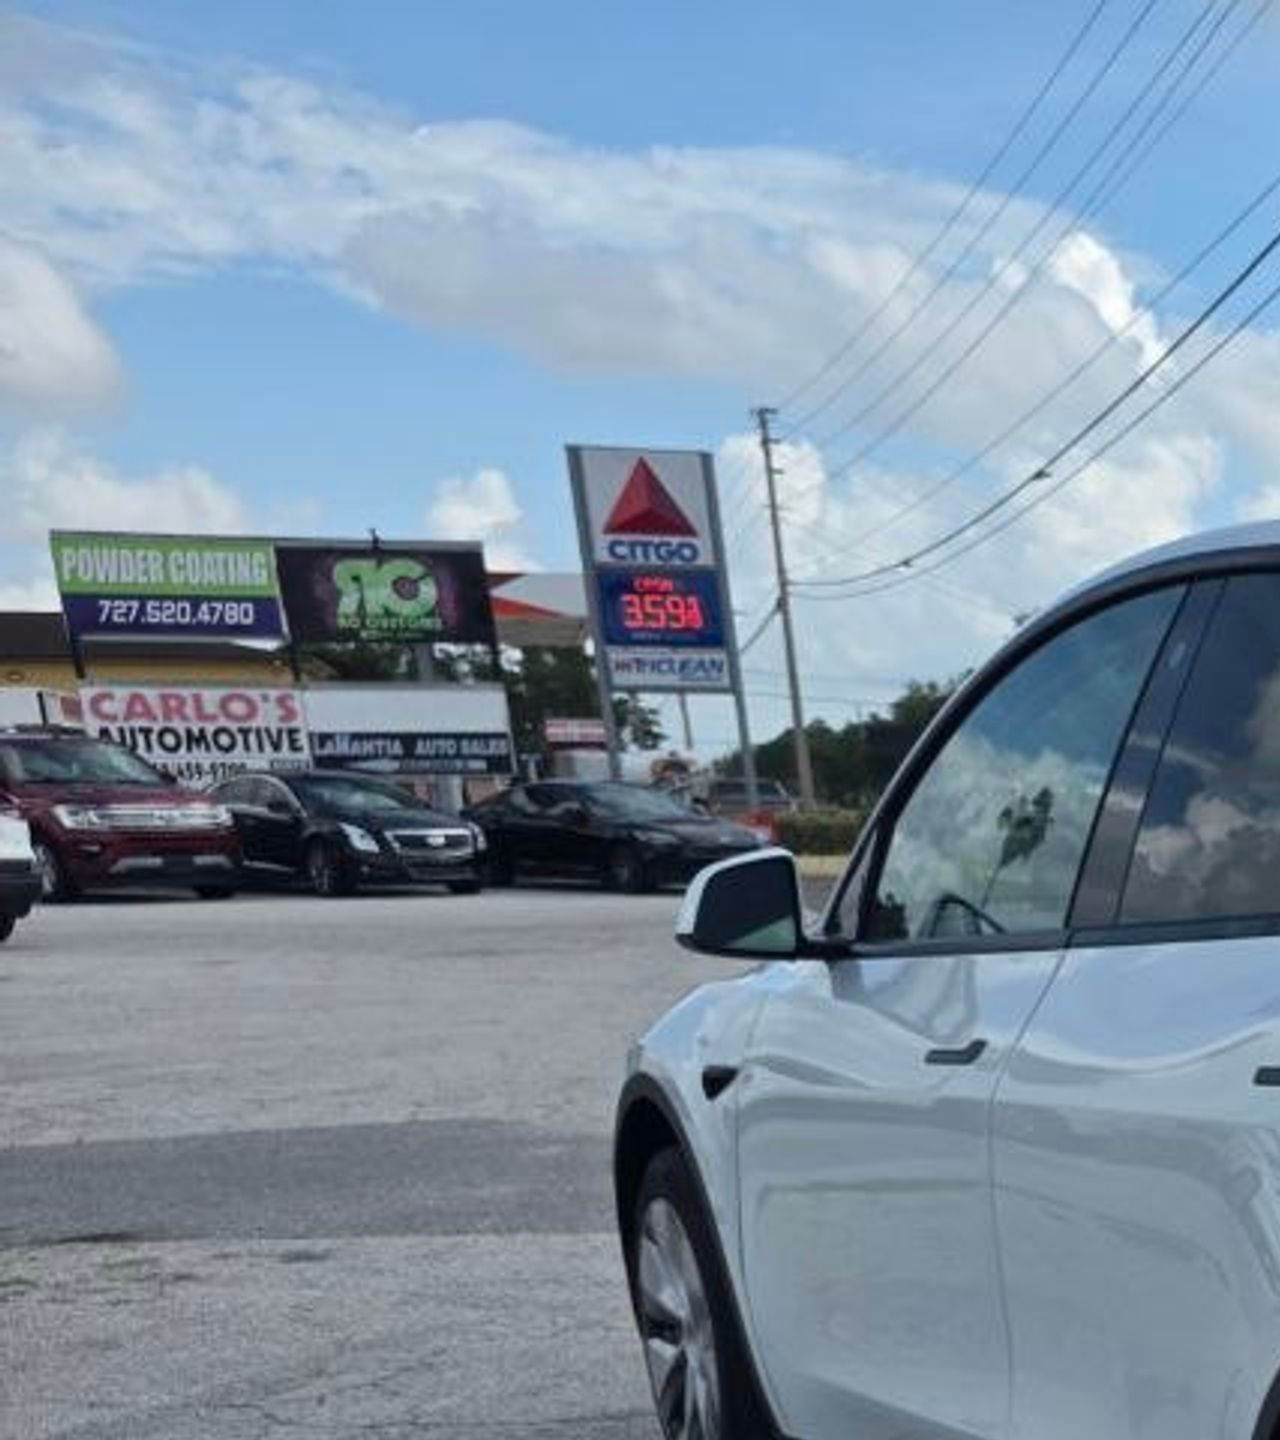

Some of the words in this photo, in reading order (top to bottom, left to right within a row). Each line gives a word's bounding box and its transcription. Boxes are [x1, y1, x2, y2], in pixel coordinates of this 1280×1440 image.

[607, 540, 699, 563] CITGO
[60, 546, 164, 583] POWDER
[168, 549, 268, 586] COATING
[98, 599, 254, 626] 727.520.4780
[89, 691, 299, 723] CARLO'S
[99, 726, 305, 754] AUTOMOTIVE
